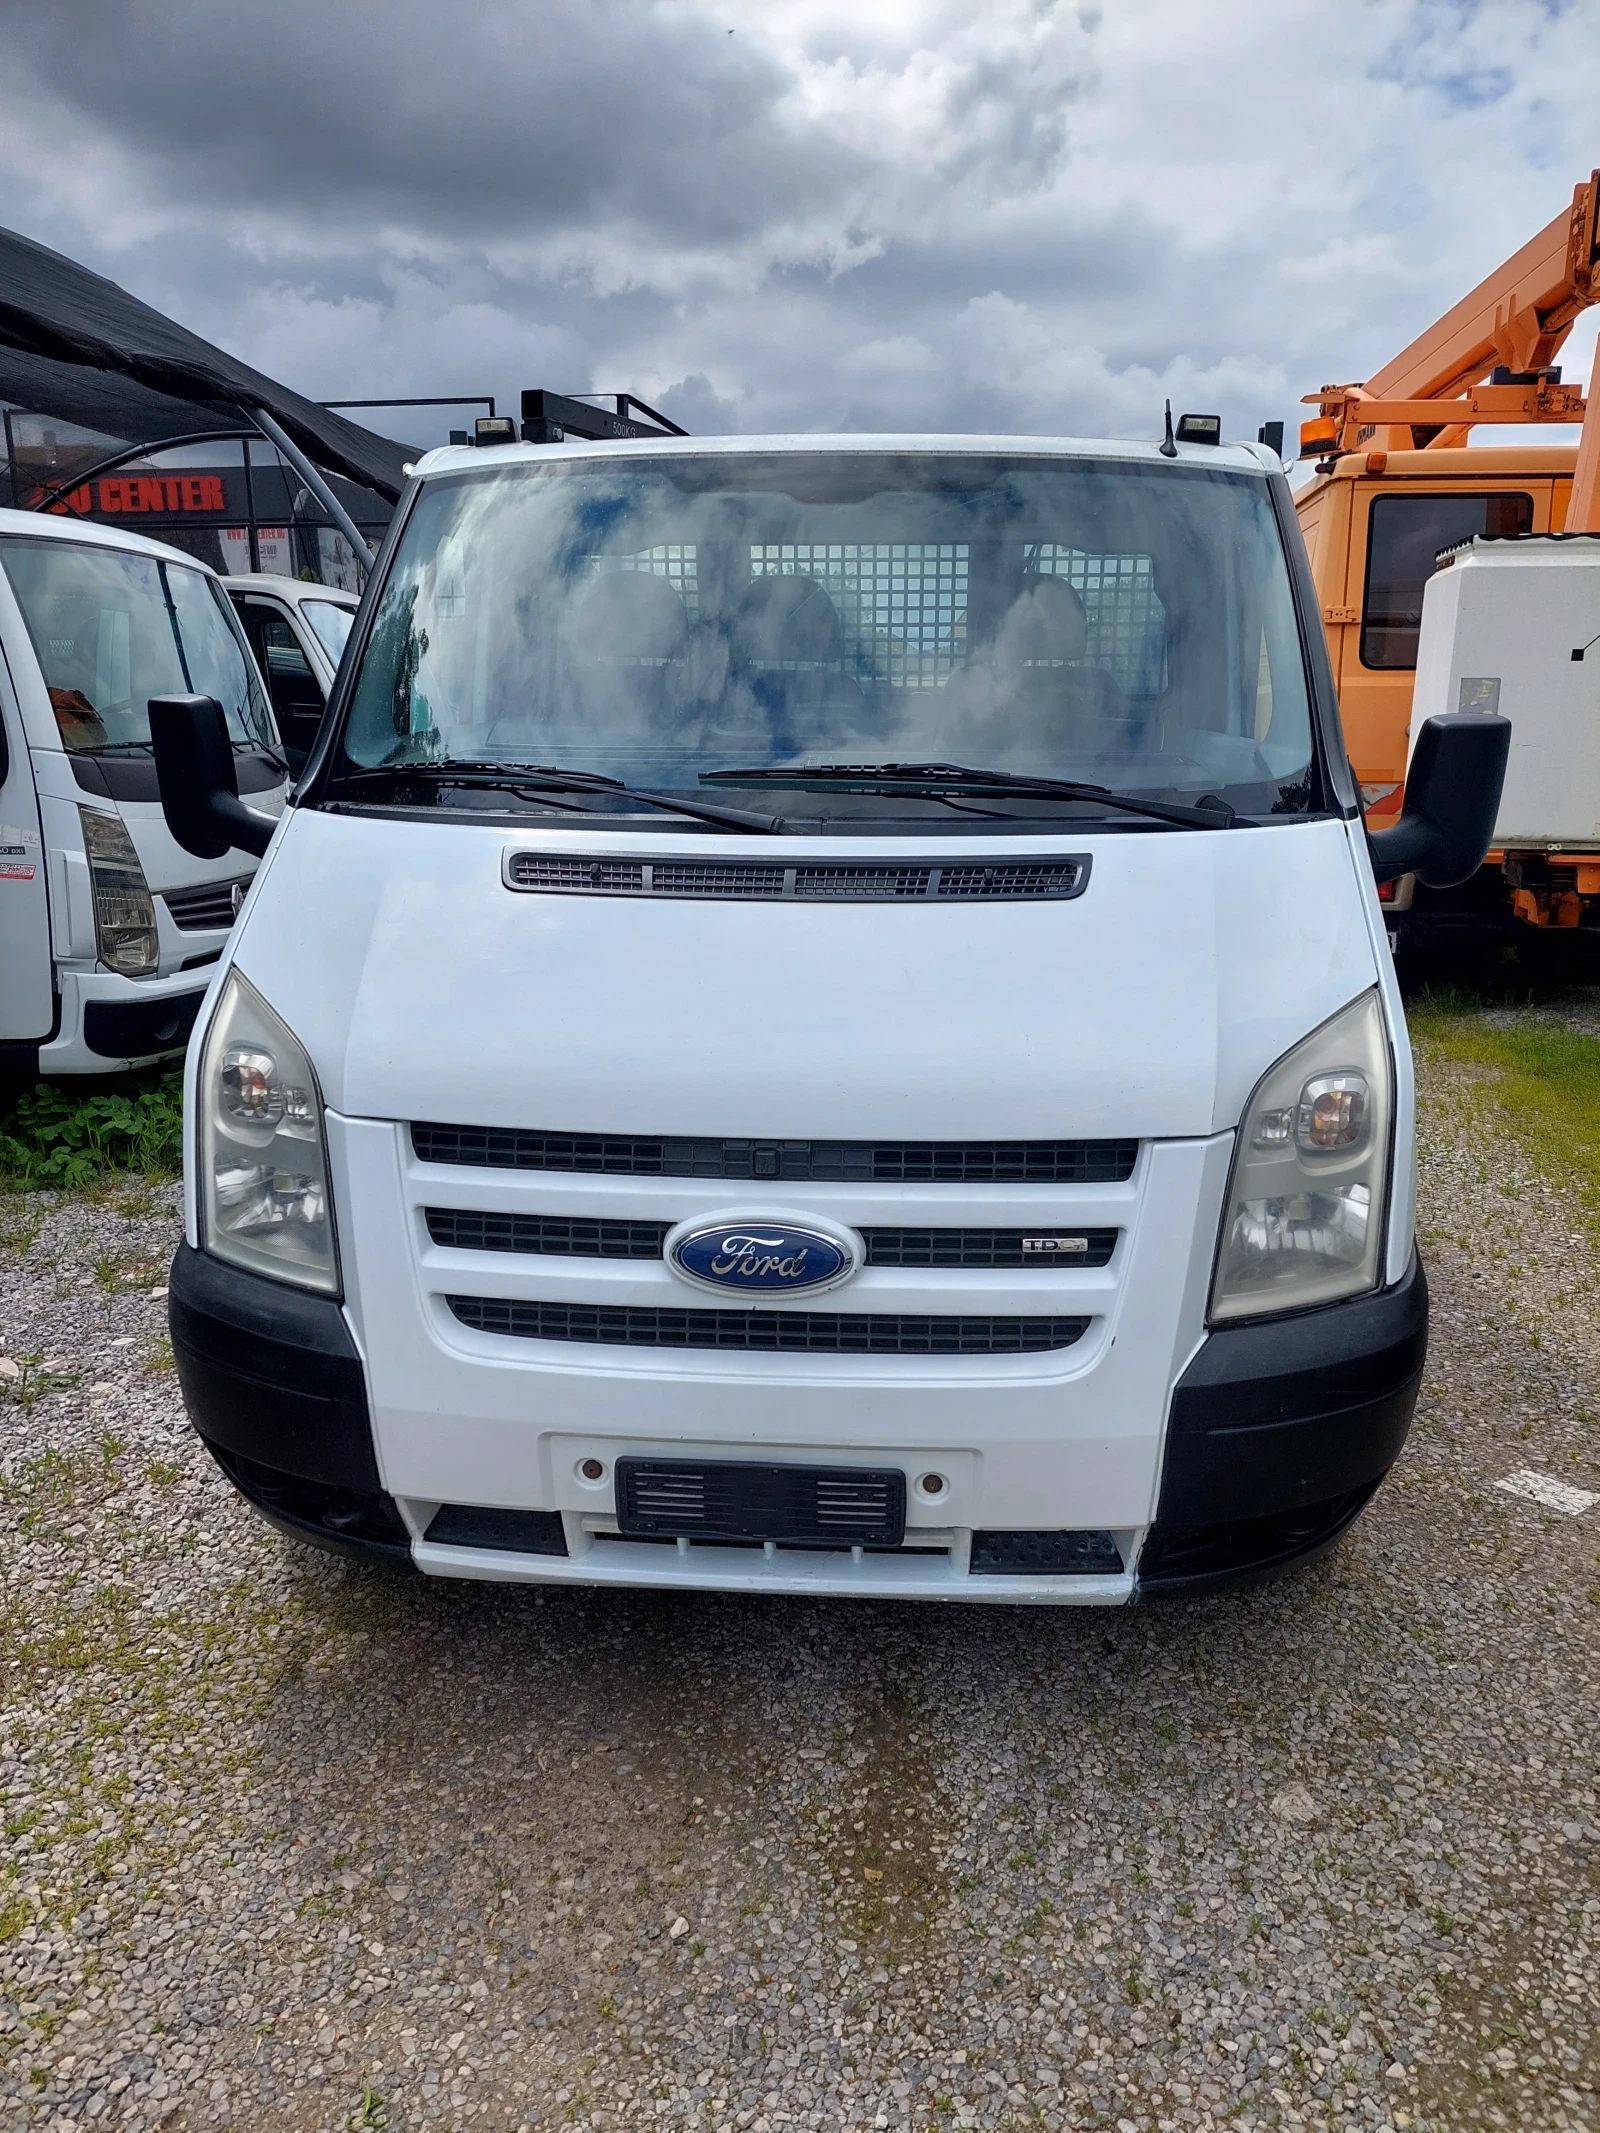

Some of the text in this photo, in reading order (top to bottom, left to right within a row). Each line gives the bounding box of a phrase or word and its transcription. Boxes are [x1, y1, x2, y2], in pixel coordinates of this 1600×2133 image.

[613, 421, 636, 438] 500KG
[101, 476, 224, 513] CENTER
[711, 1235, 809, 1277] Ford
